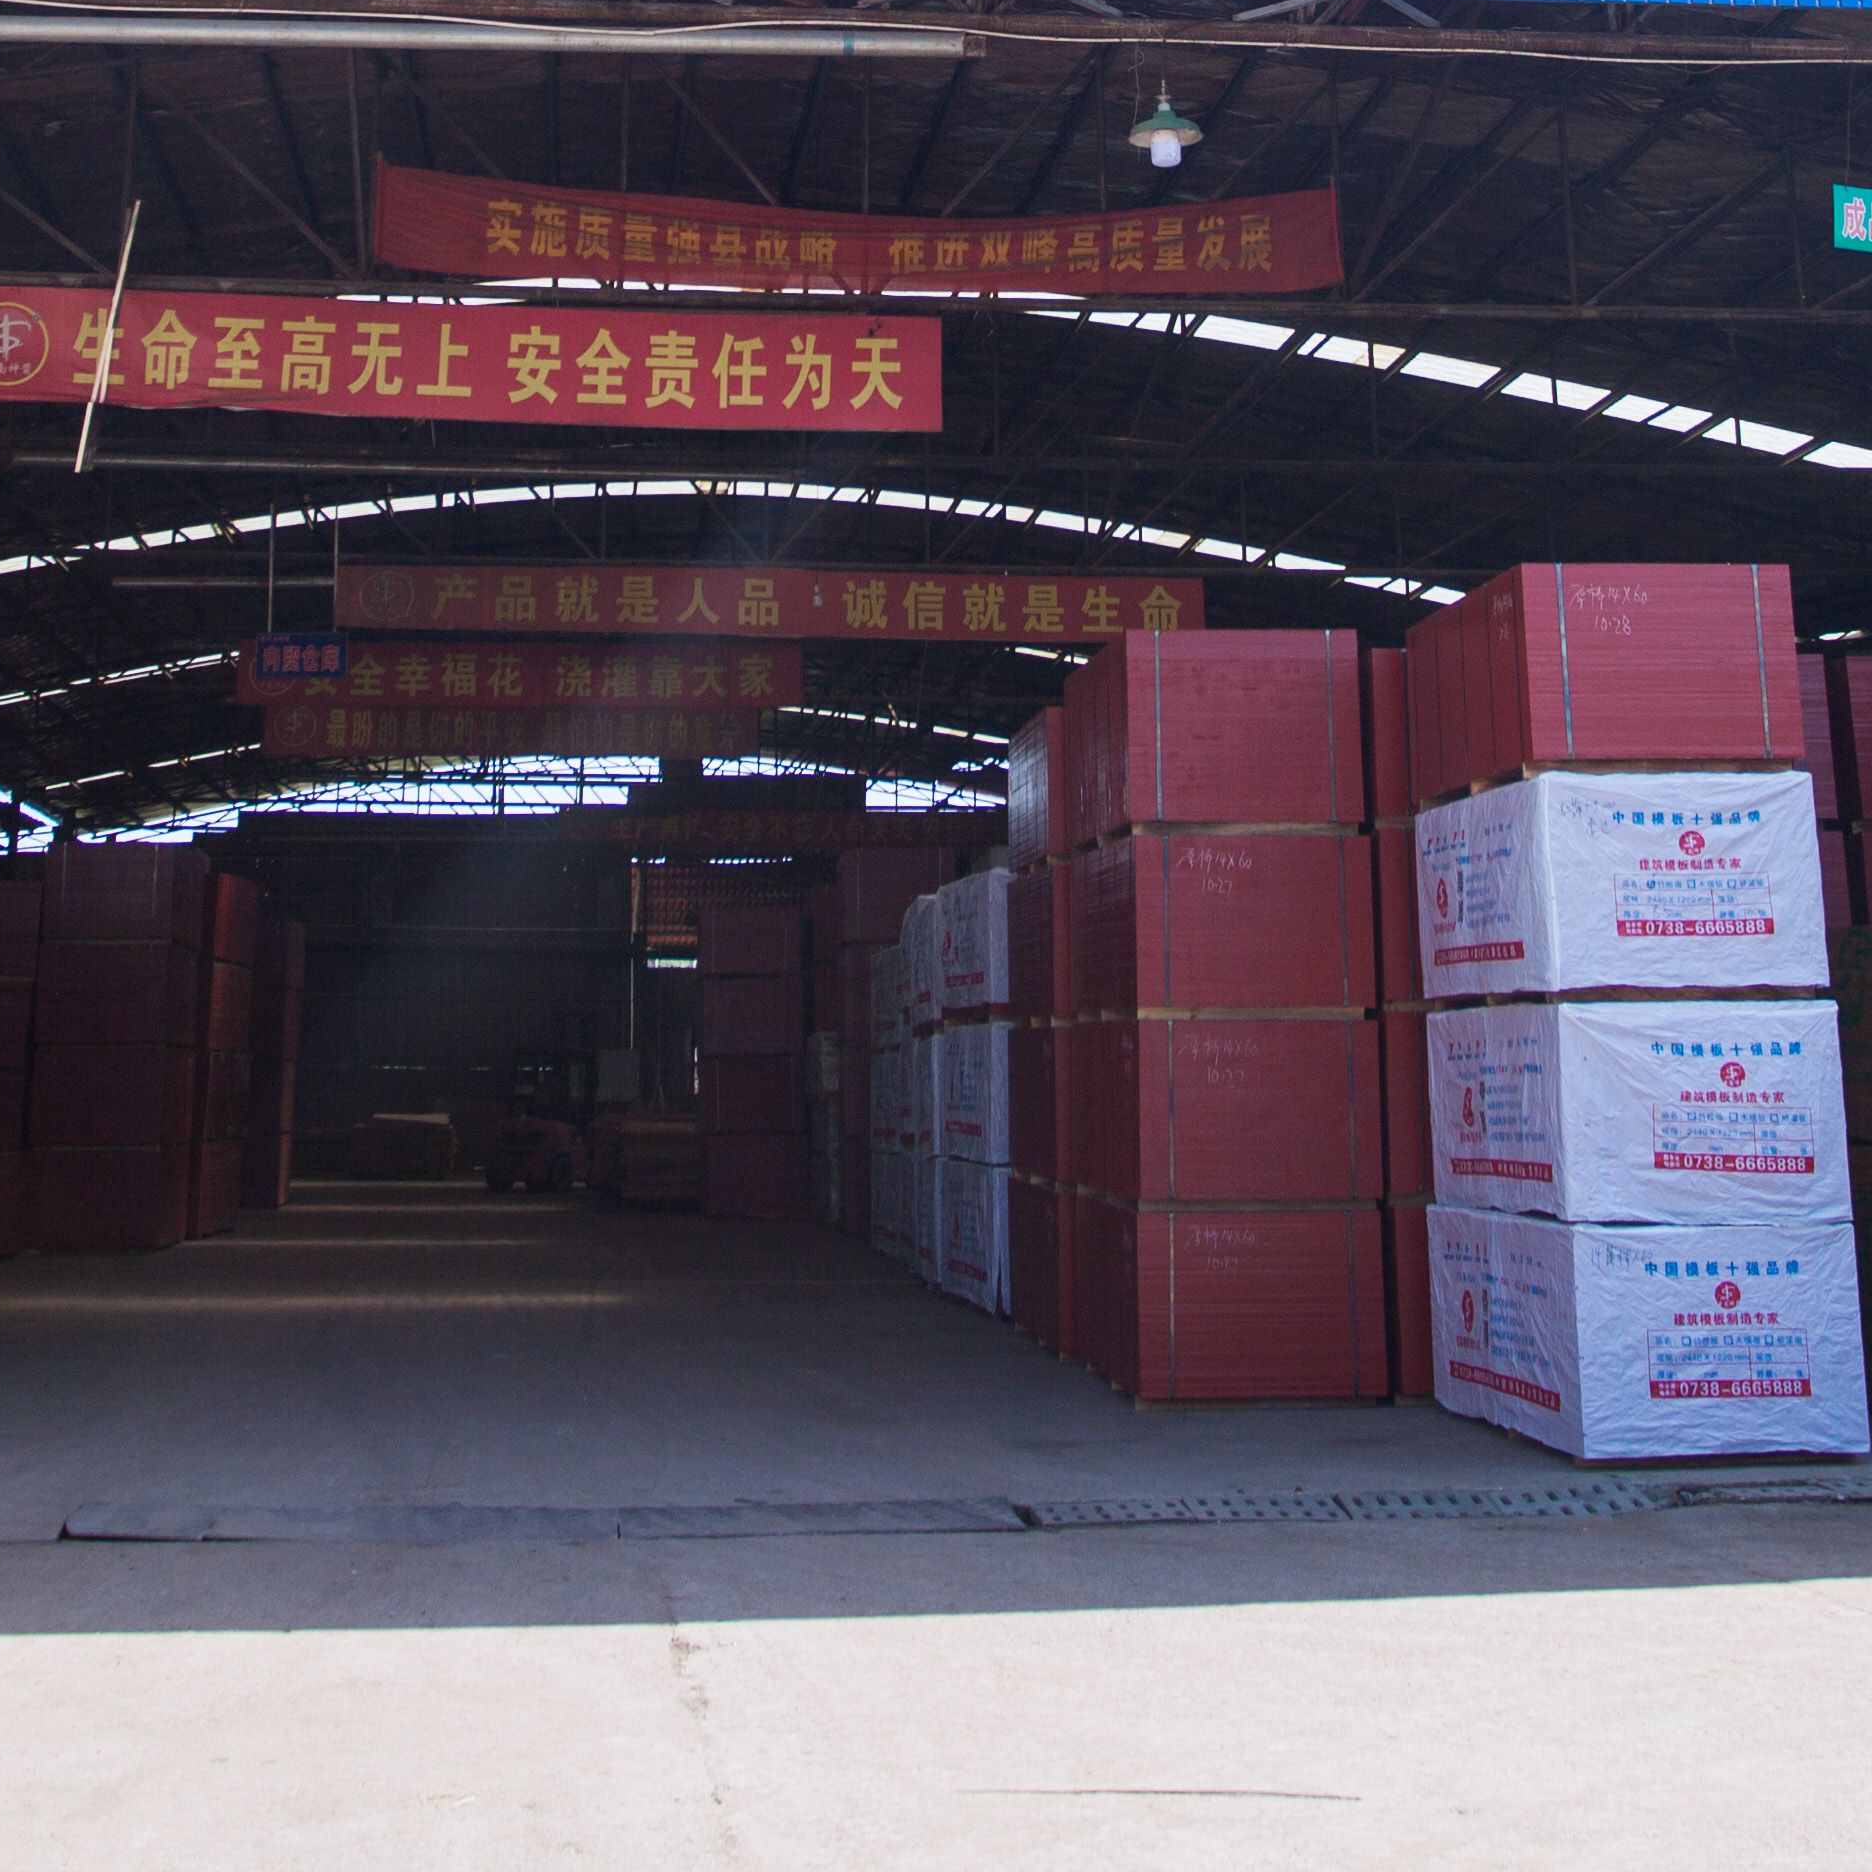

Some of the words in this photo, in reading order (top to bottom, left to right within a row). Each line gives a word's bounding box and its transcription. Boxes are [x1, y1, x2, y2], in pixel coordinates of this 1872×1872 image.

[485, 196, 838, 273] 实施质量强县战略
[888, 214, 1274, 276] 推进双峰高质量发展
[72, 308, 474, 399] 生命至高无上
[506, 325, 904, 412] 安全责任为天
[432, 573, 782, 627] 产品就是人品
[841, 581, 1184, 633] 诚信就是生命
[263, 644, 341, 673] 内贸仓库
[555, 653, 775, 699] 浇灌靠大家
[1612, 810, 1761, 826] 中国模板十强品牌
[1639, 858, 1742, 871] 建筑模板制造专家
[1645, 919, 1766, 935] 0738-6665888
[1651, 1041, 1802, 1057] 中国模板十强品牌
[1680, 1090, 1785, 1104] 建筑模板制造专家
[1683, 1154, 1806, 1171] 0738-6665888
[1644, 1260, 1800, 1276] 中国模板十强品牌
[1673, 1312, 1780, 1326] 建筑模板制造专家
[1680, 1380, 1803, 1396] 0738-6665888
